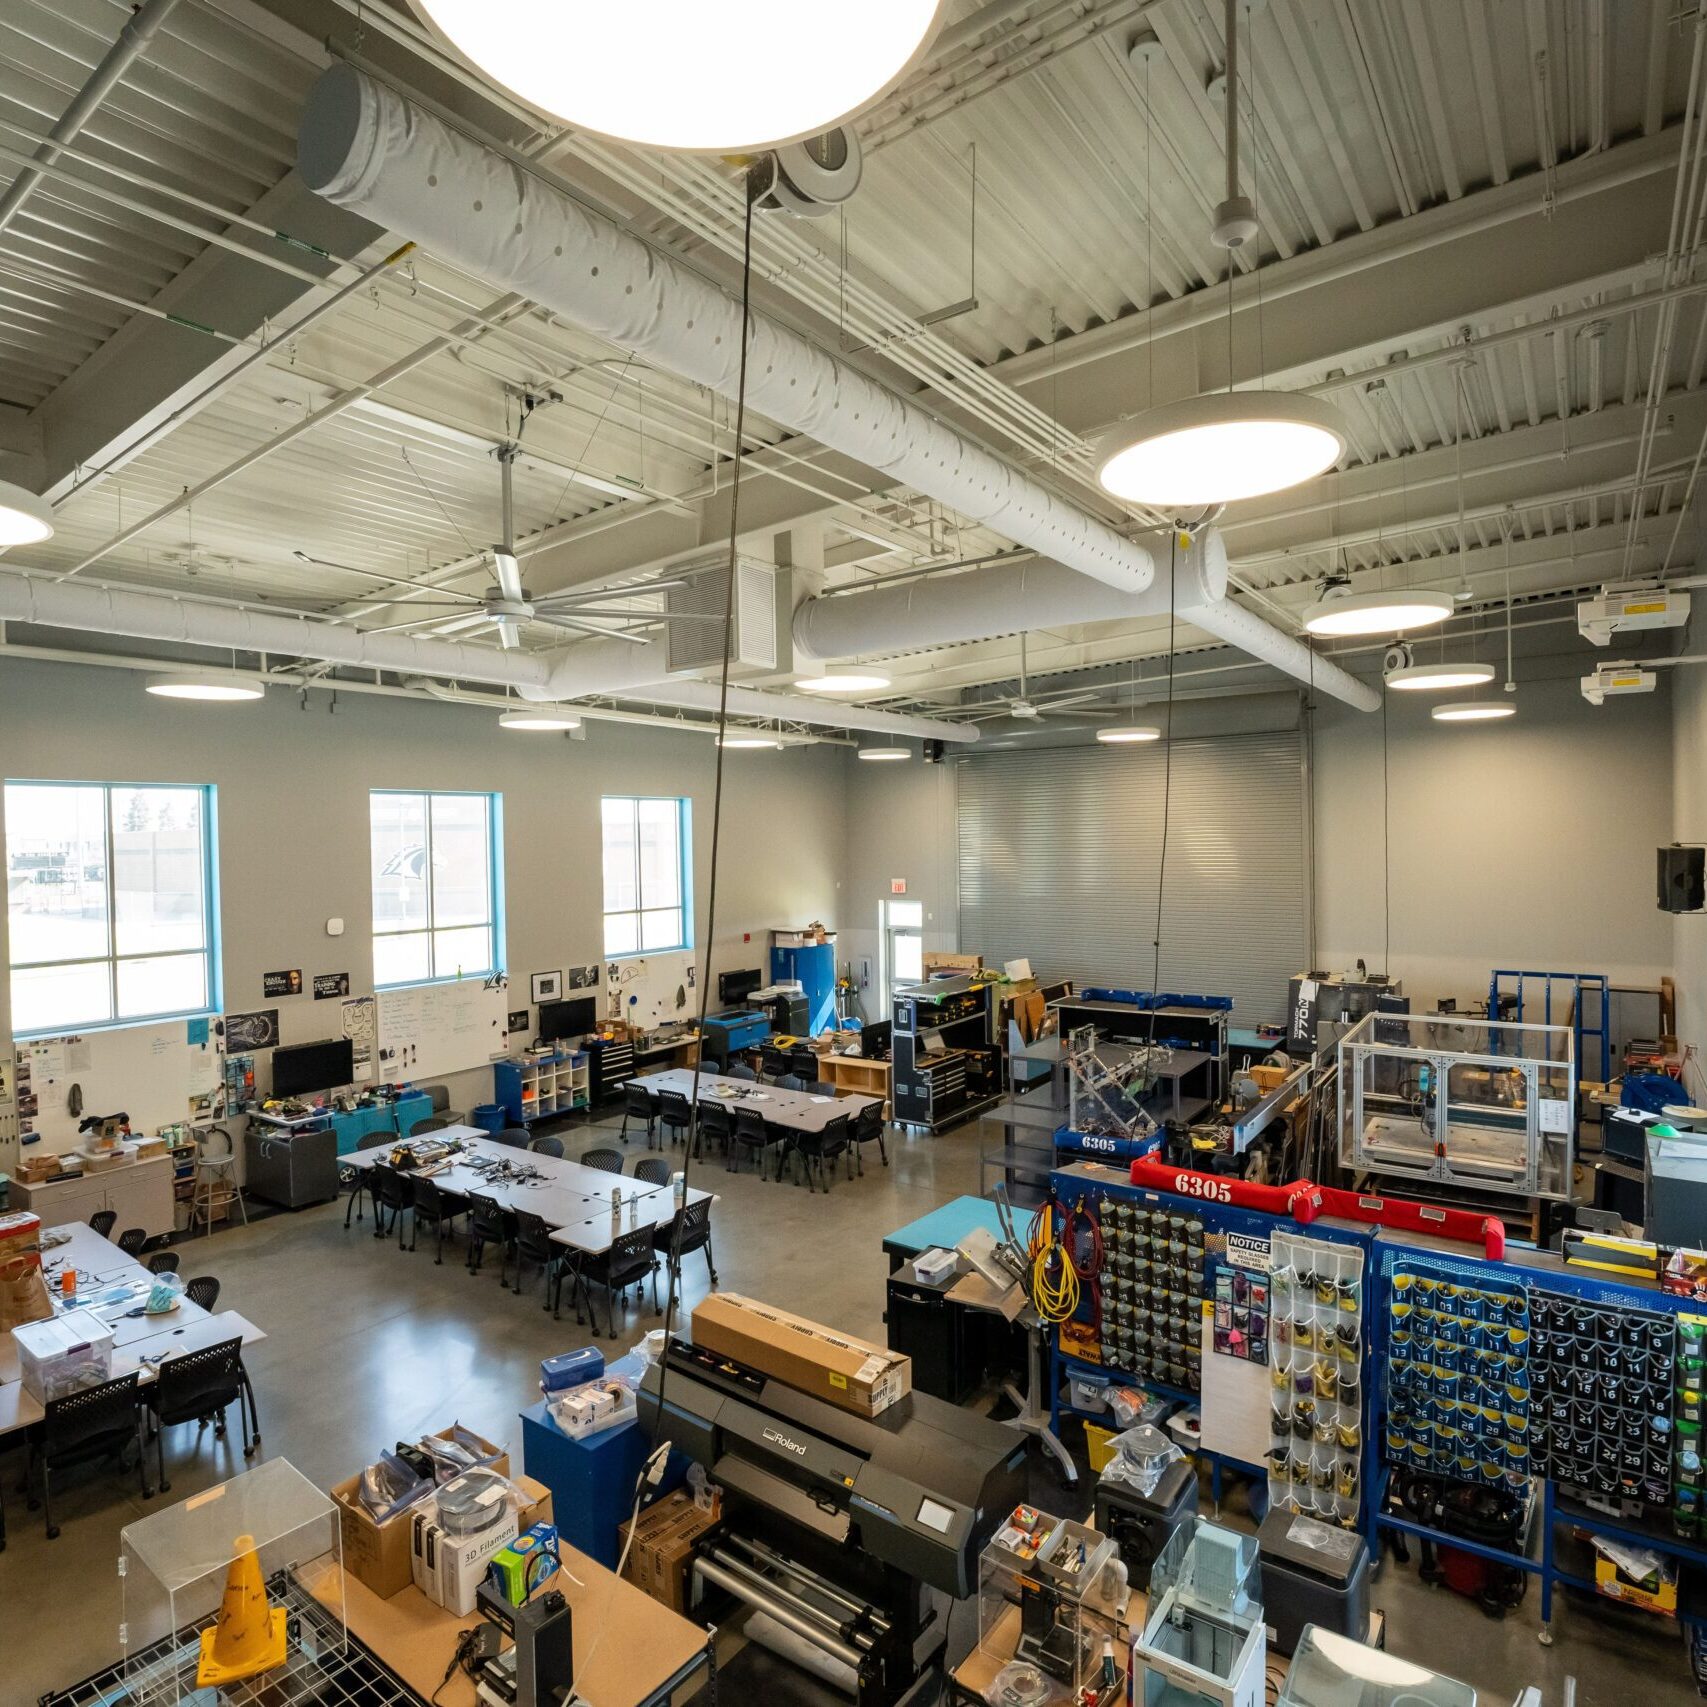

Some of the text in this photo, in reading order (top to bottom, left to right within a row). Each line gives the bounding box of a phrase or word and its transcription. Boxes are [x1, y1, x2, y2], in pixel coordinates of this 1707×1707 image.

[1082, 1136, 1116, 1152] 6305
[1175, 1173, 1232, 1203] 6305
[1230, 1235, 1270, 1253] NOTICE
[1230, 1247, 1269, 1261] SAFETY GLASSES
[1237, 1254, 1262, 1264] REQUIRED
[1251, 1261, 1265, 1269] AREA
[1396, 1290, 1406, 1300] 01
[1416, 1296, 1428, 1306] 02
[1440, 1301, 1452, 1312] 03
[1464, 1307, 1477, 1316] 04
[1489, 1312, 1503, 1322] 05
[1416, 1323, 1428, 1334] 08
[1464, 1334, 1476, 1345] 10
[1489, 1339, 1500, 1351] 11
[1556, 1317, 1565, 1326] 2
[1577, 1322, 1586, 1331] 3
[1606, 1329, 1615, 1338] 4
[1630, 1332, 1638, 1341] 5
[1652, 1338, 1662, 1348] 6
[1394, 1348, 1407, 1357] 13
[1440, 1358, 1451, 1368] 15
[1464, 1362, 1476, 1373] 16
[1488, 1368, 1500, 1379] 17
[1536, 1344, 1668, 1380] 7 8 9 10 11 12
[1438, 1384, 1450, 1394] 21
[1463, 1391, 1476, 1402] 22
[1487, 1398, 1500, 1409] 23
[1531, 1373, 1545, 1383] 13
[1554, 1376, 1568, 1388] 14
[1577, 1382, 1592, 1394] 15
[1602, 1389, 1616, 1399] 16
[1650, 1398, 1665, 1411] 18
[1415, 1408, 1428, 1418] 26
[1437, 1413, 1449, 1424] 27
[1461, 1421, 1474, 1432] 28
[1486, 1425, 1499, 1436] 29
[1529, 1403, 1543, 1413] 19
[1552, 1408, 1567, 1417] 20
[1579, 1414, 1592, 1424] 21
[1626, 1425, 1640, 1436] 23
[1651, 1431, 1667, 1444] 24
[774, 1433, 807, 1456] Roland
[1416, 1433, 1428, 1444] 32
[1555, 1439, 1570, 1450] 26
[1624, 1454, 1641, 1466] 29
[1652, 1461, 1668, 1475] 30
[1531, 1462, 1545, 1471] 31
[1557, 1467, 1573, 1478] 32
[1622, 1485, 1639, 1495] 35
[1647, 1491, 1665, 1503] 36
[465, 1549, 477, 1563] 3D
[479, 1525, 515, 1553] Filament
[678, 1524, 700, 1540] SUPPLY
